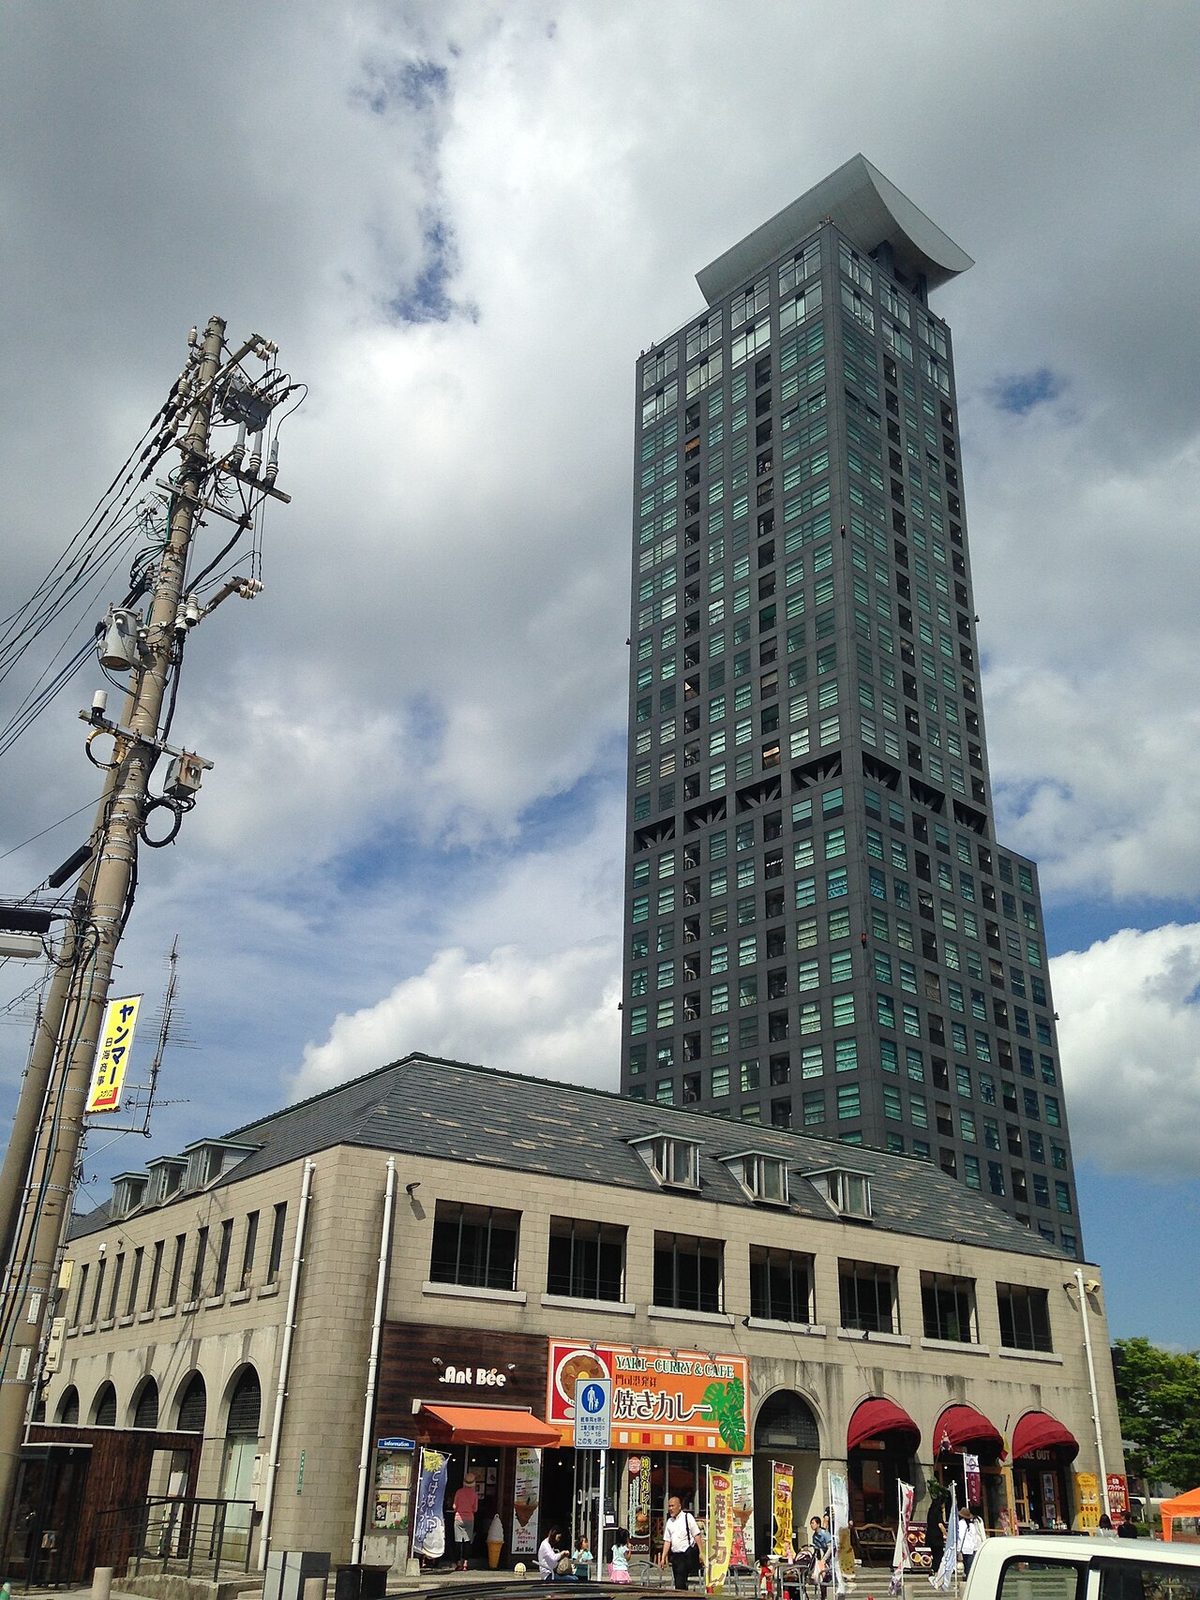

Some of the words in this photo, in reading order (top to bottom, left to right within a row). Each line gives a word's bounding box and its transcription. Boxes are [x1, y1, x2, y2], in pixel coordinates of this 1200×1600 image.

[109, 1003, 135, 1085] ヤンマー
[444, 1366, 472, 1384] Ant
[615, 1354, 693, 1374] YAKI-CURRY
[694, 1363, 704, 1375] &
[704, 1363, 735, 1378] CAFE
[614, 1389, 713, 1423] 焼きカレー
